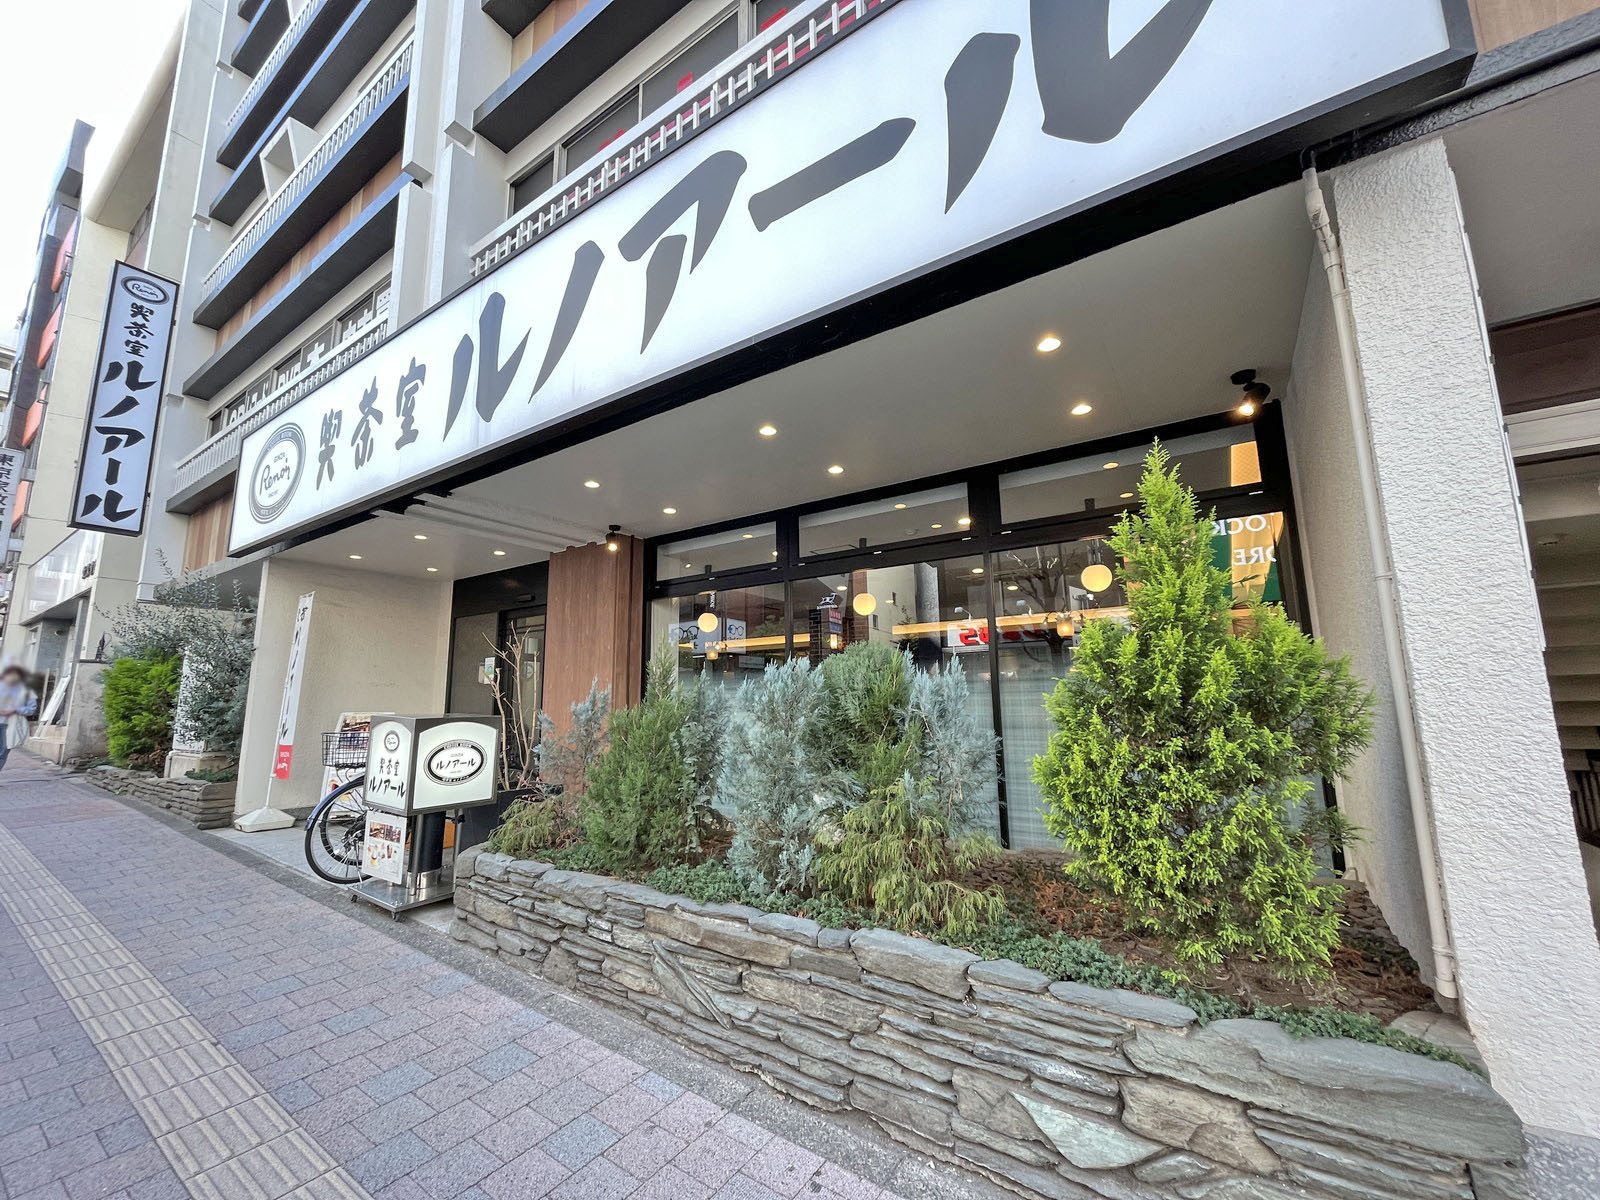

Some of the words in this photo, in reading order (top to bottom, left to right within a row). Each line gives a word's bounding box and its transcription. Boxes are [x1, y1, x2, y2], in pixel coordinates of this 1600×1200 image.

[435, 758, 477, 771] ルノアール
[368, 776, 407, 799] ルノアール
